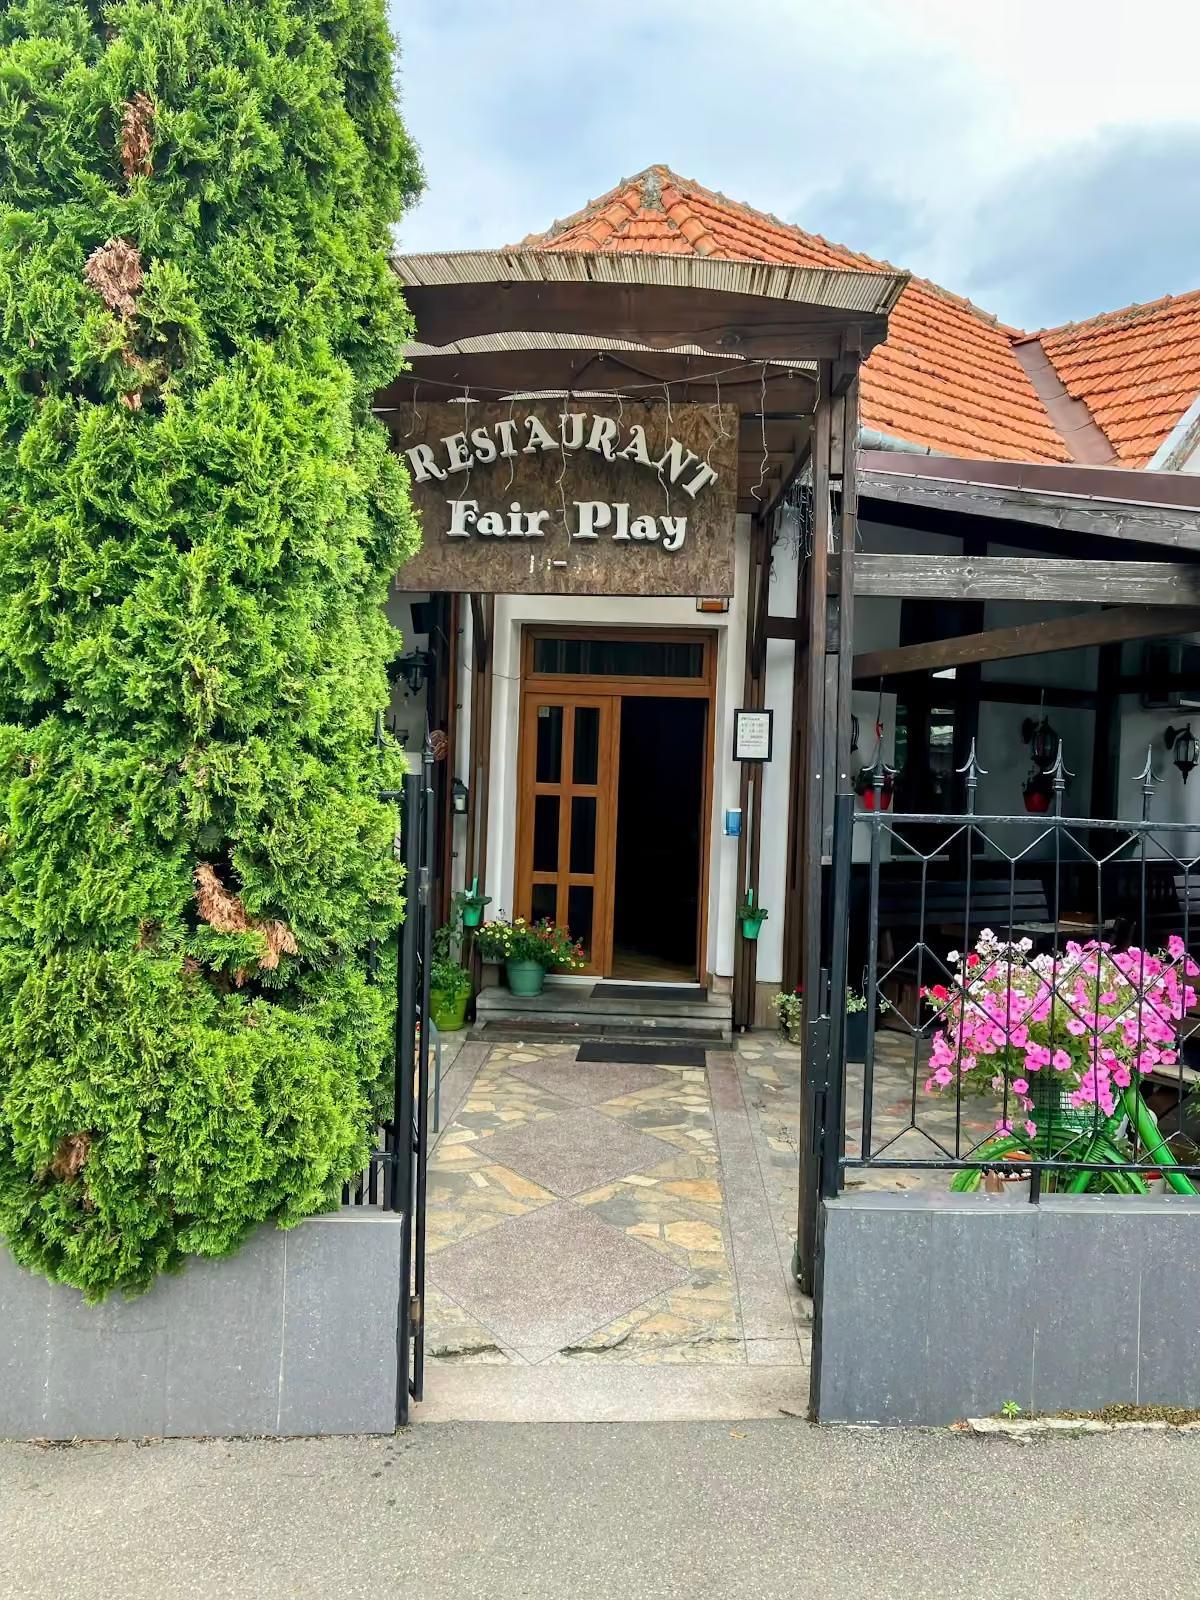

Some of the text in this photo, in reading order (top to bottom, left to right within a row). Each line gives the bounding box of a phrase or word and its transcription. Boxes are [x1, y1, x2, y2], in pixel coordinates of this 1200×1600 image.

[405, 413, 718, 499] RESTAURANT
[446, 500, 687, 551] Fair Play
